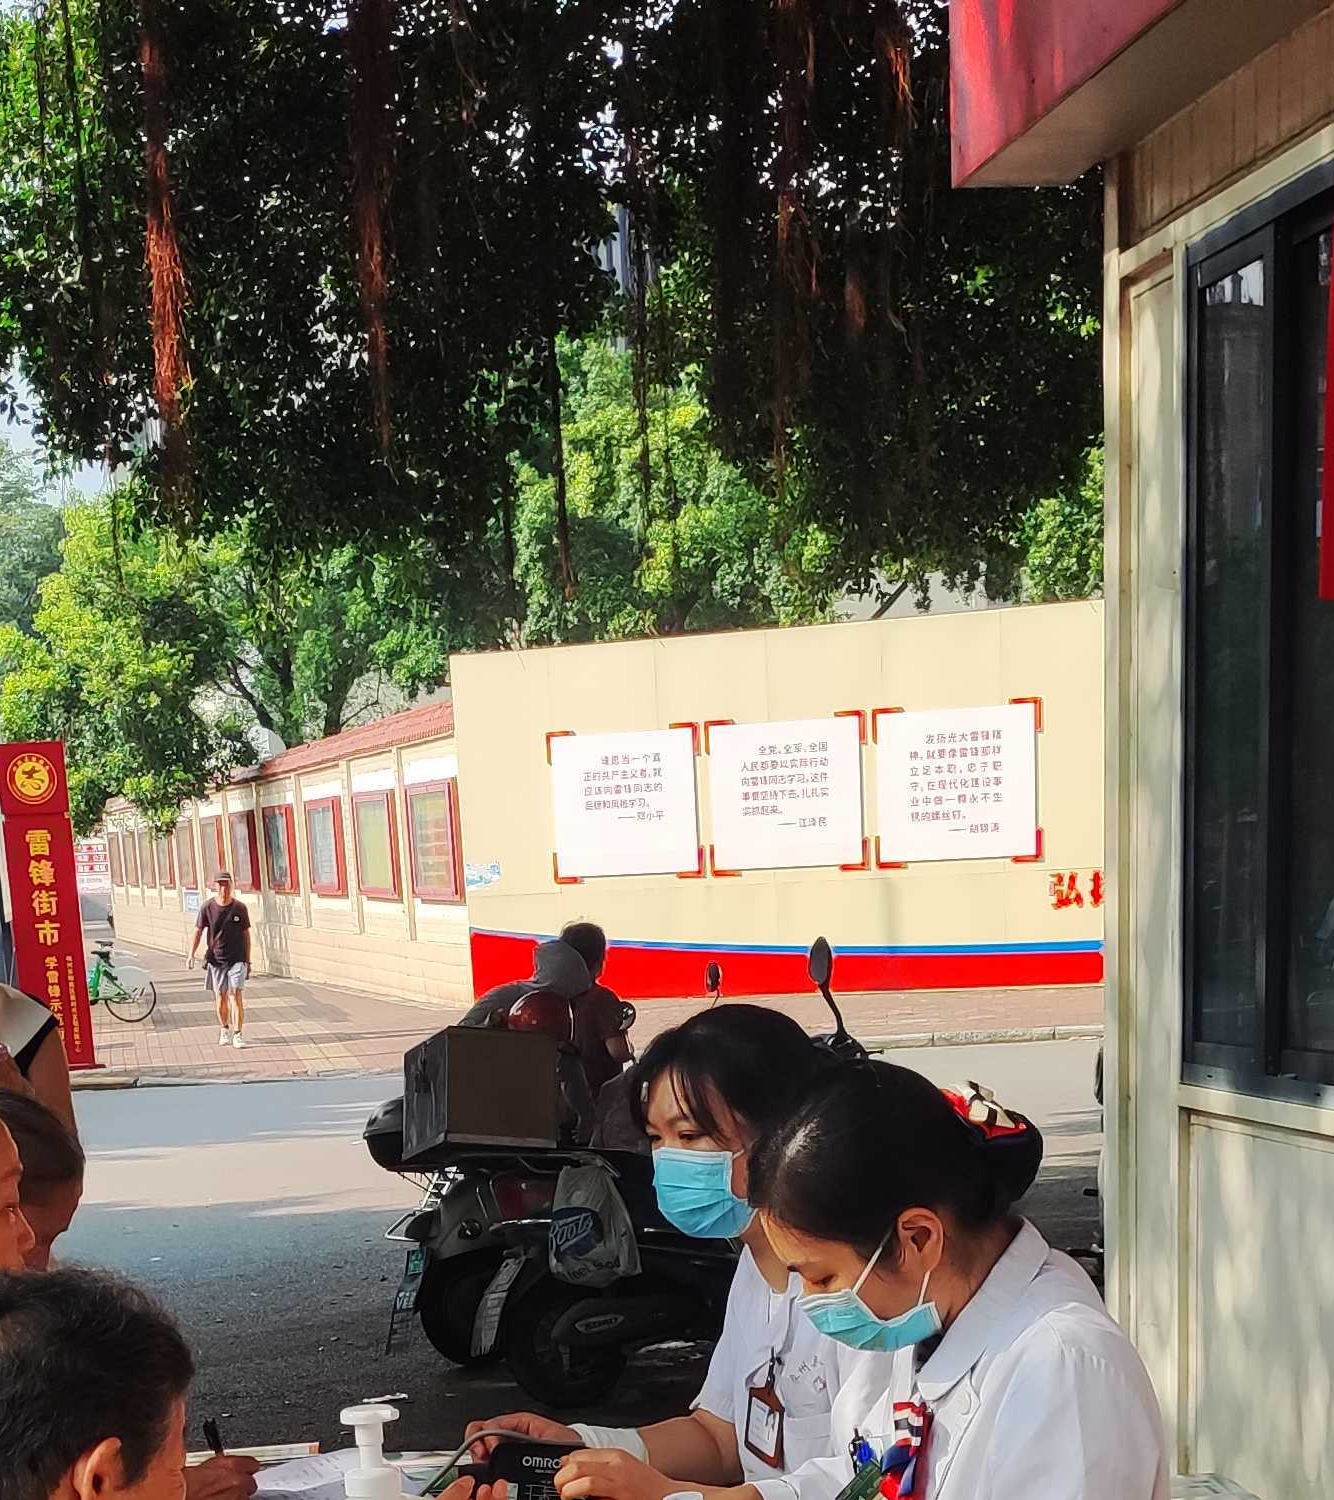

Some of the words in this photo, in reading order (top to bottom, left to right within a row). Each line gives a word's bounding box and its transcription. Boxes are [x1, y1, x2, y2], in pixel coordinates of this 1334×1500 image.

[24, 829, 61, 947] 雷锋街市
[522, 1456, 562, 1469] OMRO
